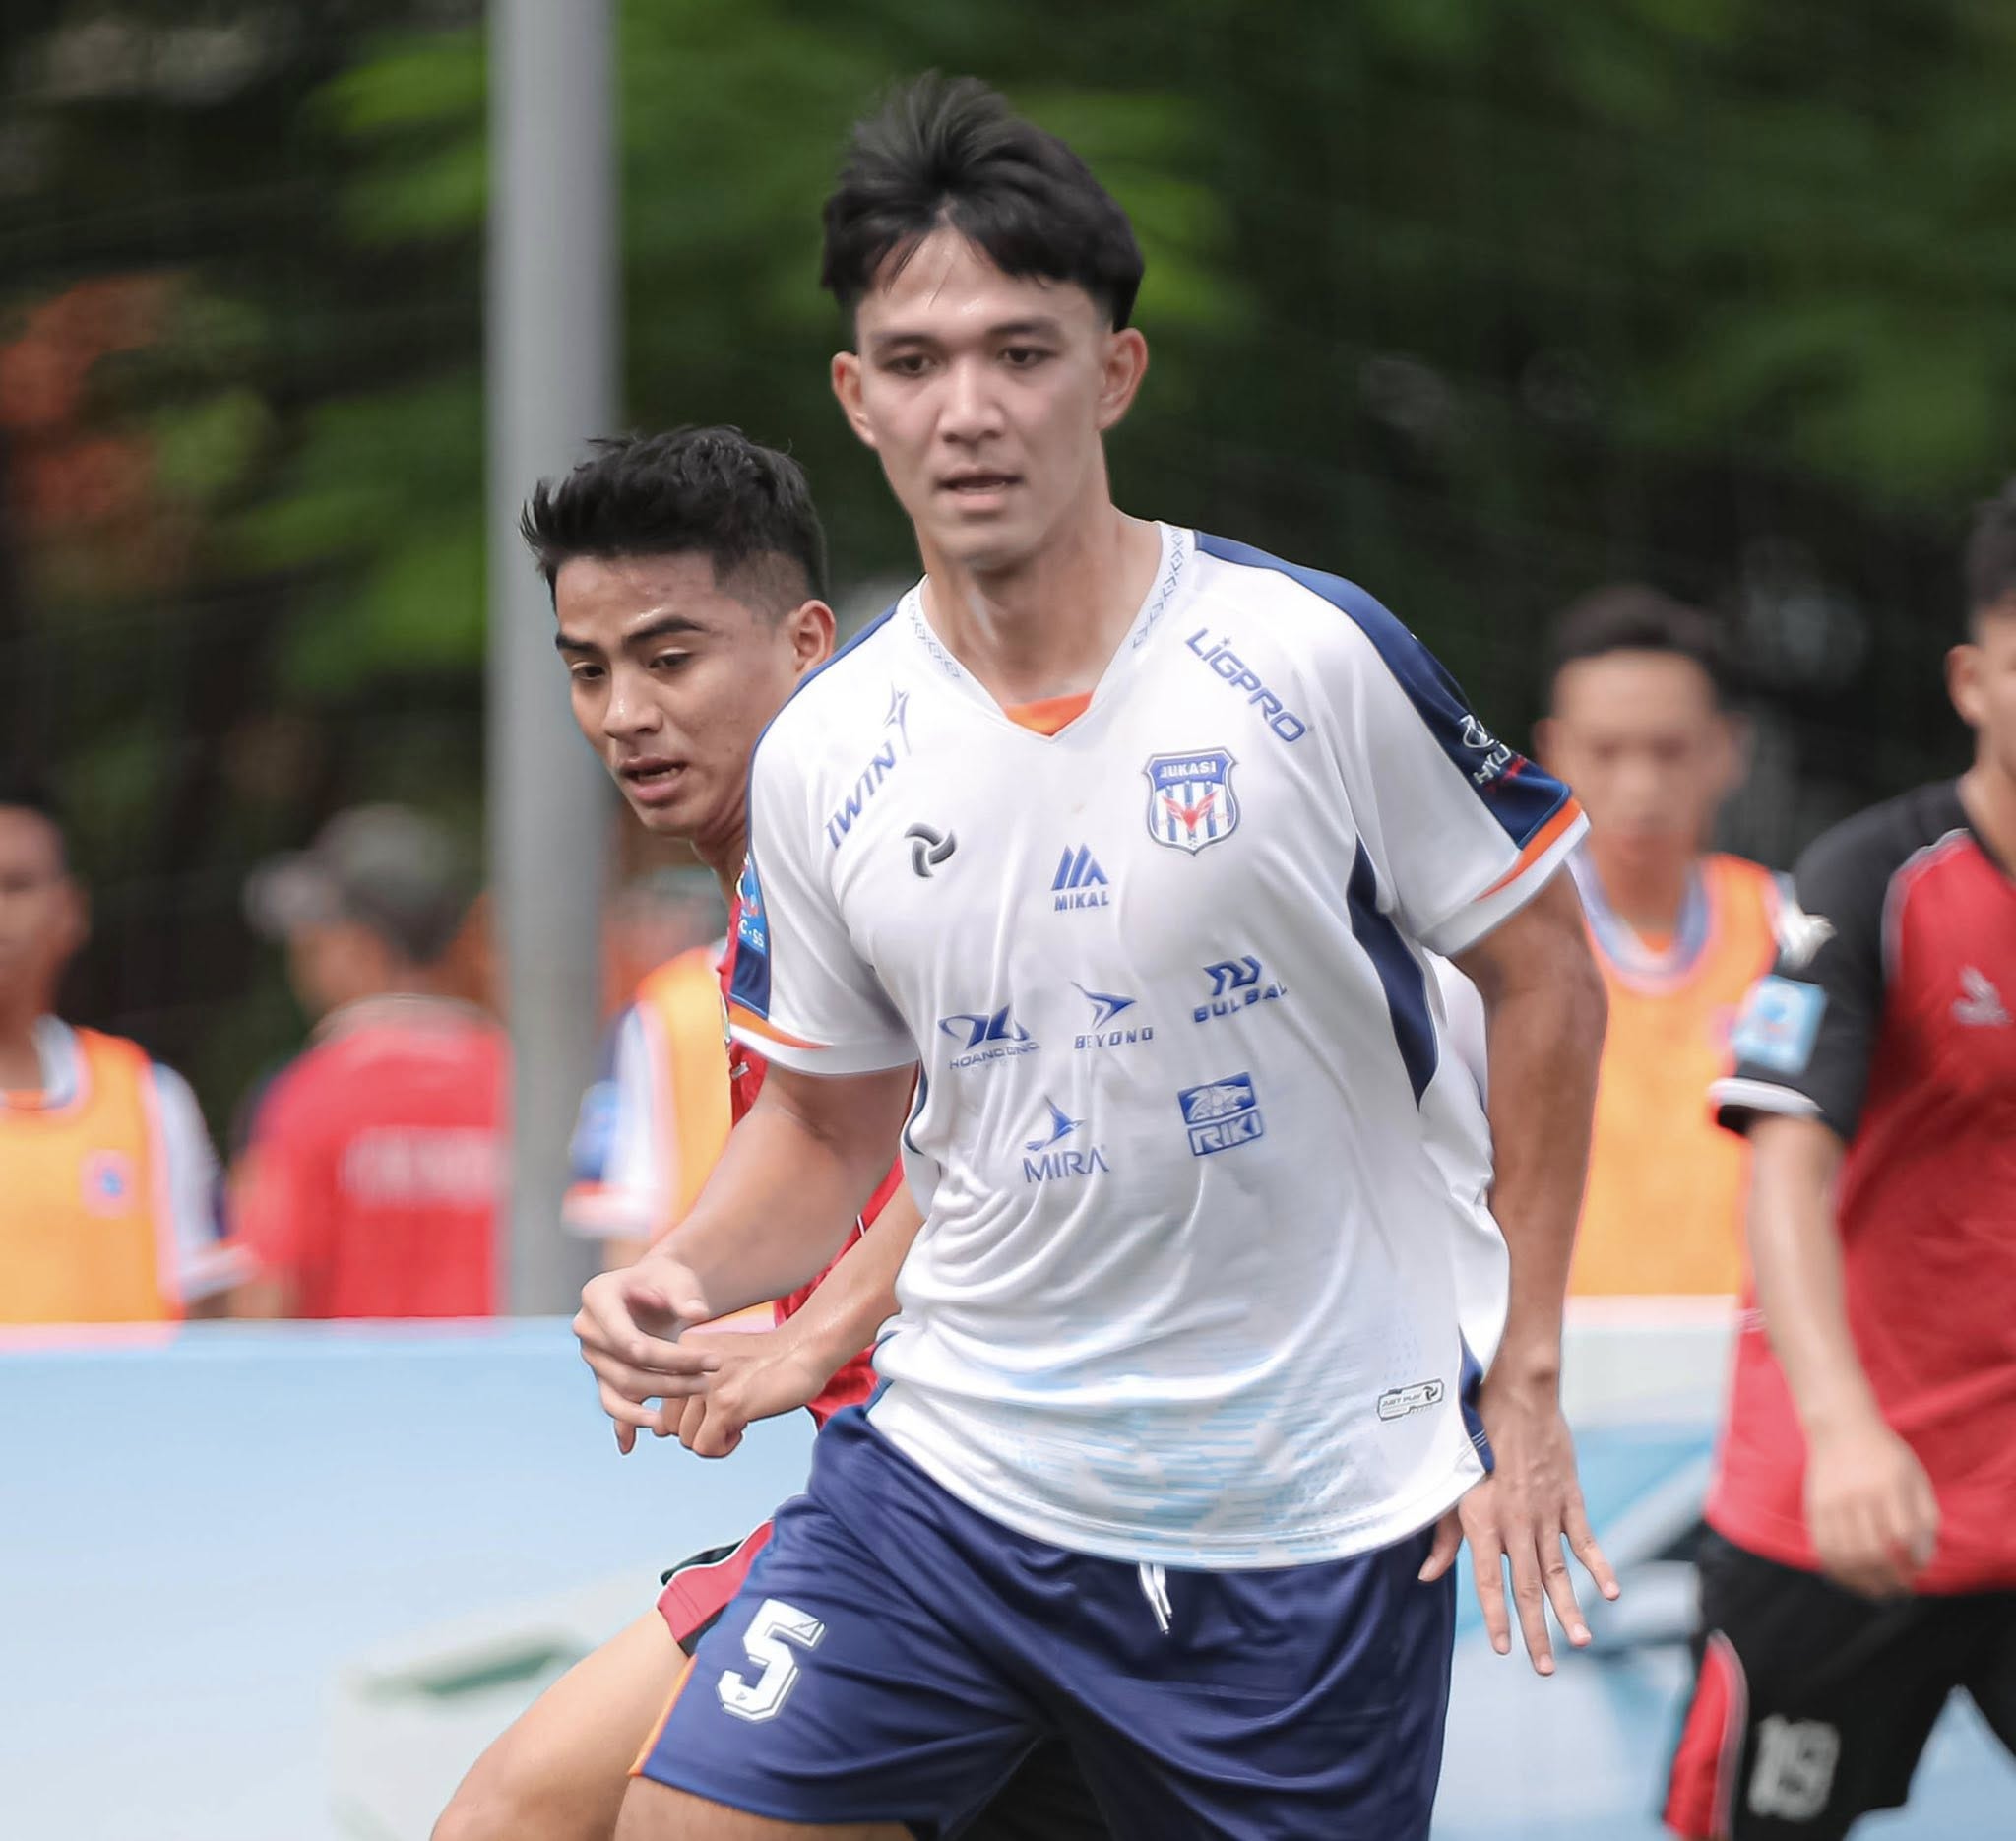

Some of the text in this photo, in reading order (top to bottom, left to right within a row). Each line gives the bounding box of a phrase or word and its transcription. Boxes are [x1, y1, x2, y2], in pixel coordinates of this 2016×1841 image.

[1160, 760, 1217, 778] JUKASI
[1054, 890, 1109, 911] MIKAL
[1075, 1027, 1153, 1049] BEYOND
[1191, 1111, 1262, 1154] RIKI
[1023, 1146, 1109, 1183] MIRA
[718, 1598, 826, 1722] 5
